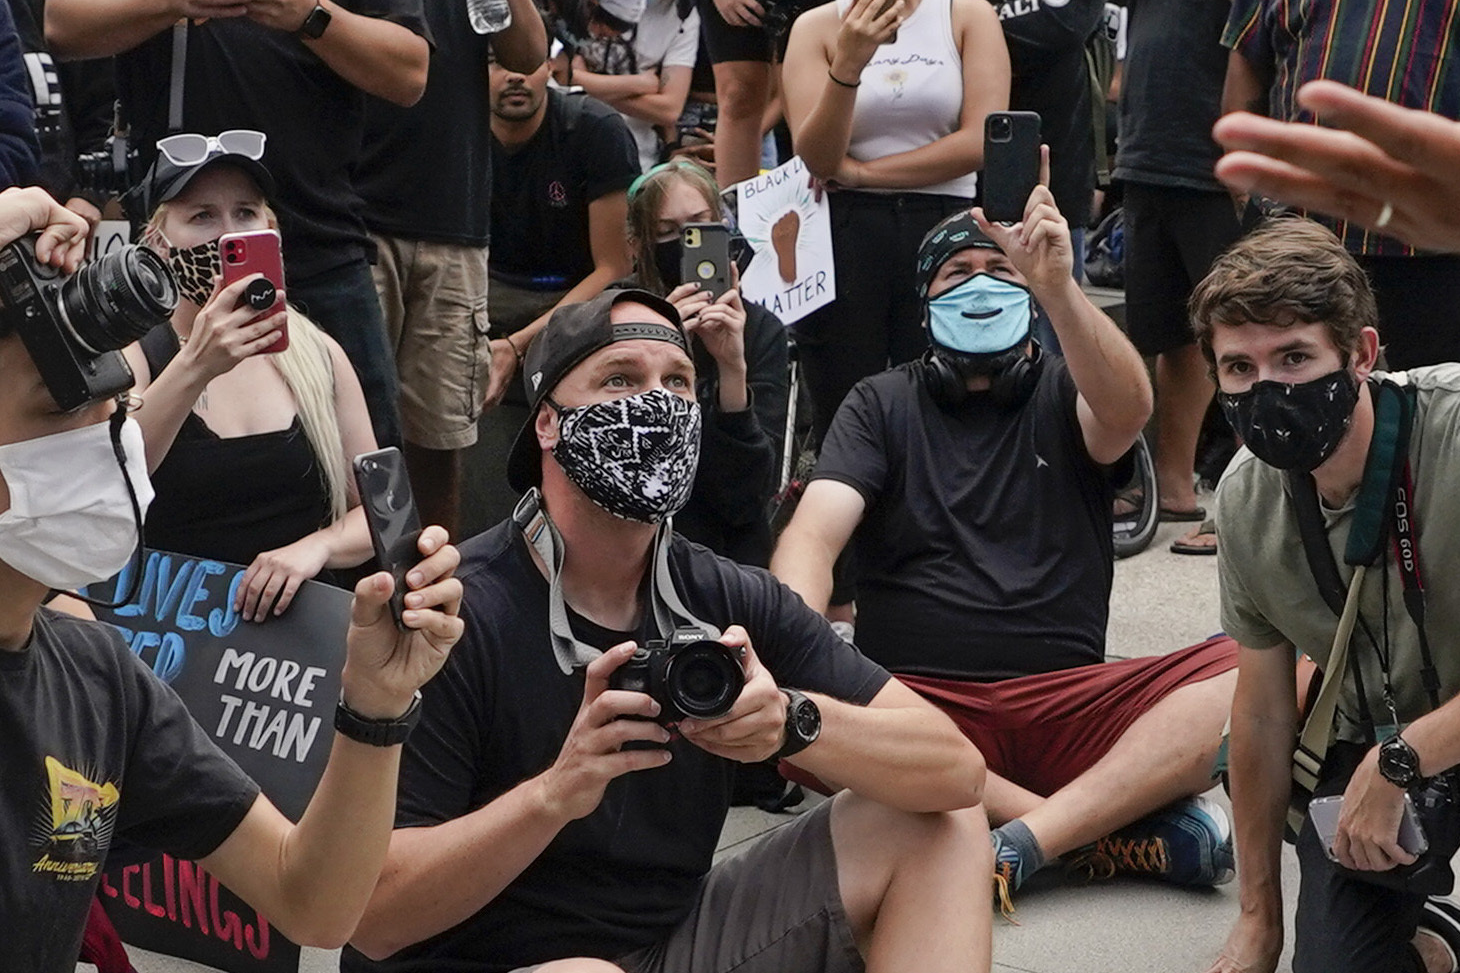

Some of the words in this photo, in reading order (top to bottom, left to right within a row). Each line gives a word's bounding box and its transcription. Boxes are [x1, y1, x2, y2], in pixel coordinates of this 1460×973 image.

[744, 166, 791, 199] BLACK
[1400, 538, 1414, 572] 60D
[214, 648, 327, 708] MORE
[215, 694, 322, 764] THAN
